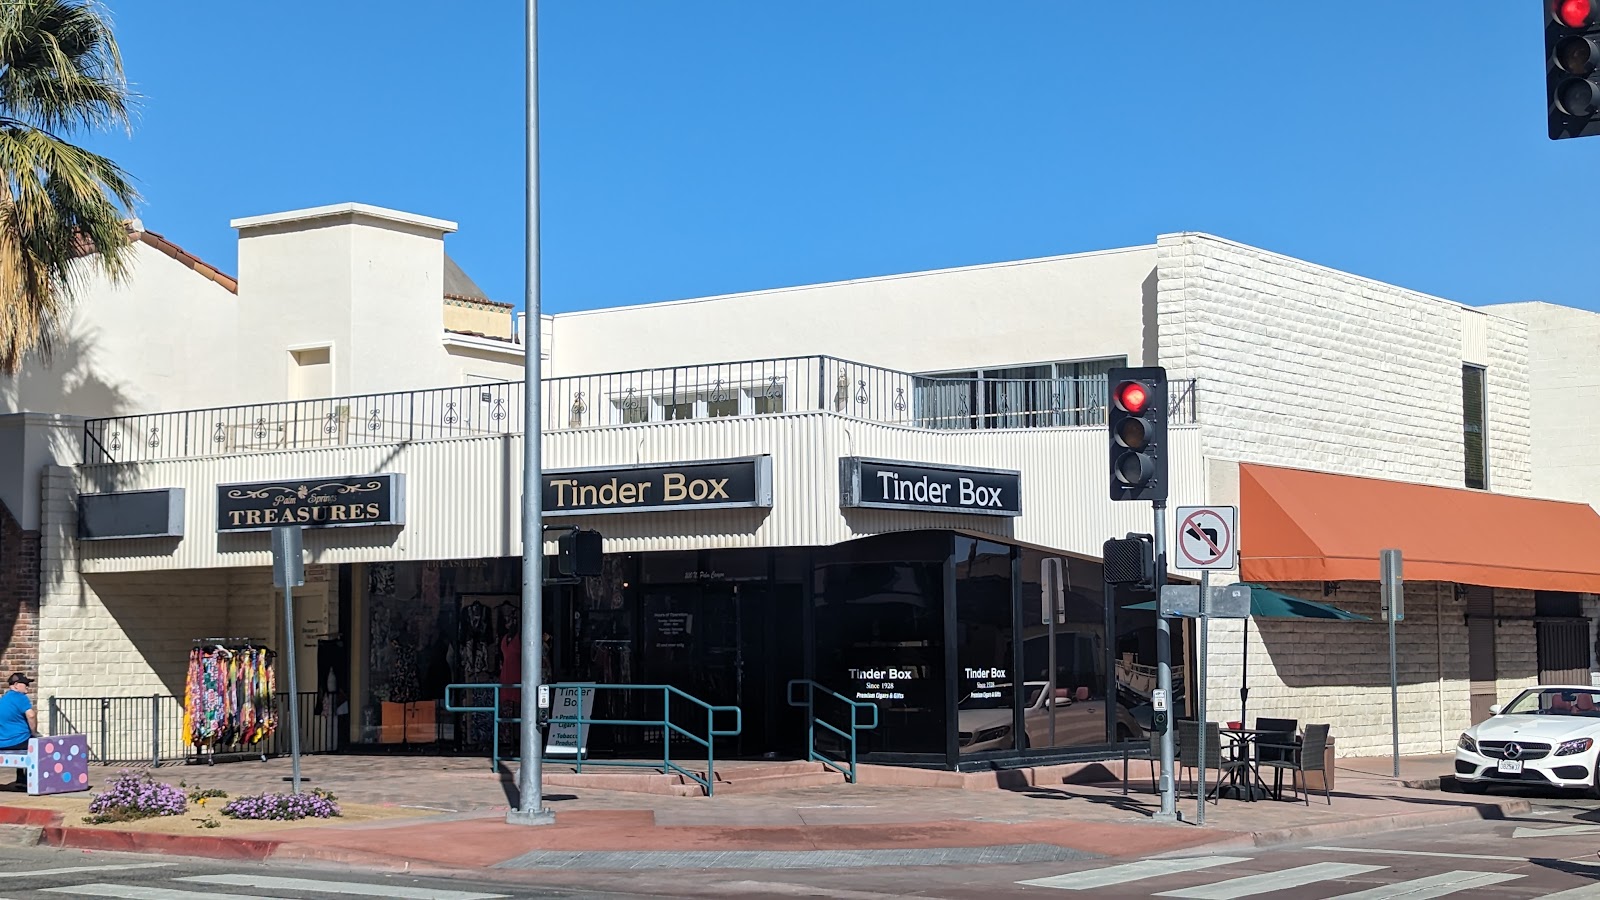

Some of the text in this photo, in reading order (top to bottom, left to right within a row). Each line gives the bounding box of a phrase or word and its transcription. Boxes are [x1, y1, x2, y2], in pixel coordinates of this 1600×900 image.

[549, 472, 730, 507] Tinder Box
[876, 470, 1003, 507] Tinder Box
[272, 493, 338, 507] Palm Springs
[228, 502, 381, 526] TREASURES
[848, 668, 912, 680] Tinder Box
[964, 667, 1006, 679] Tinder Box
[564, 698, 583, 707] Bo
